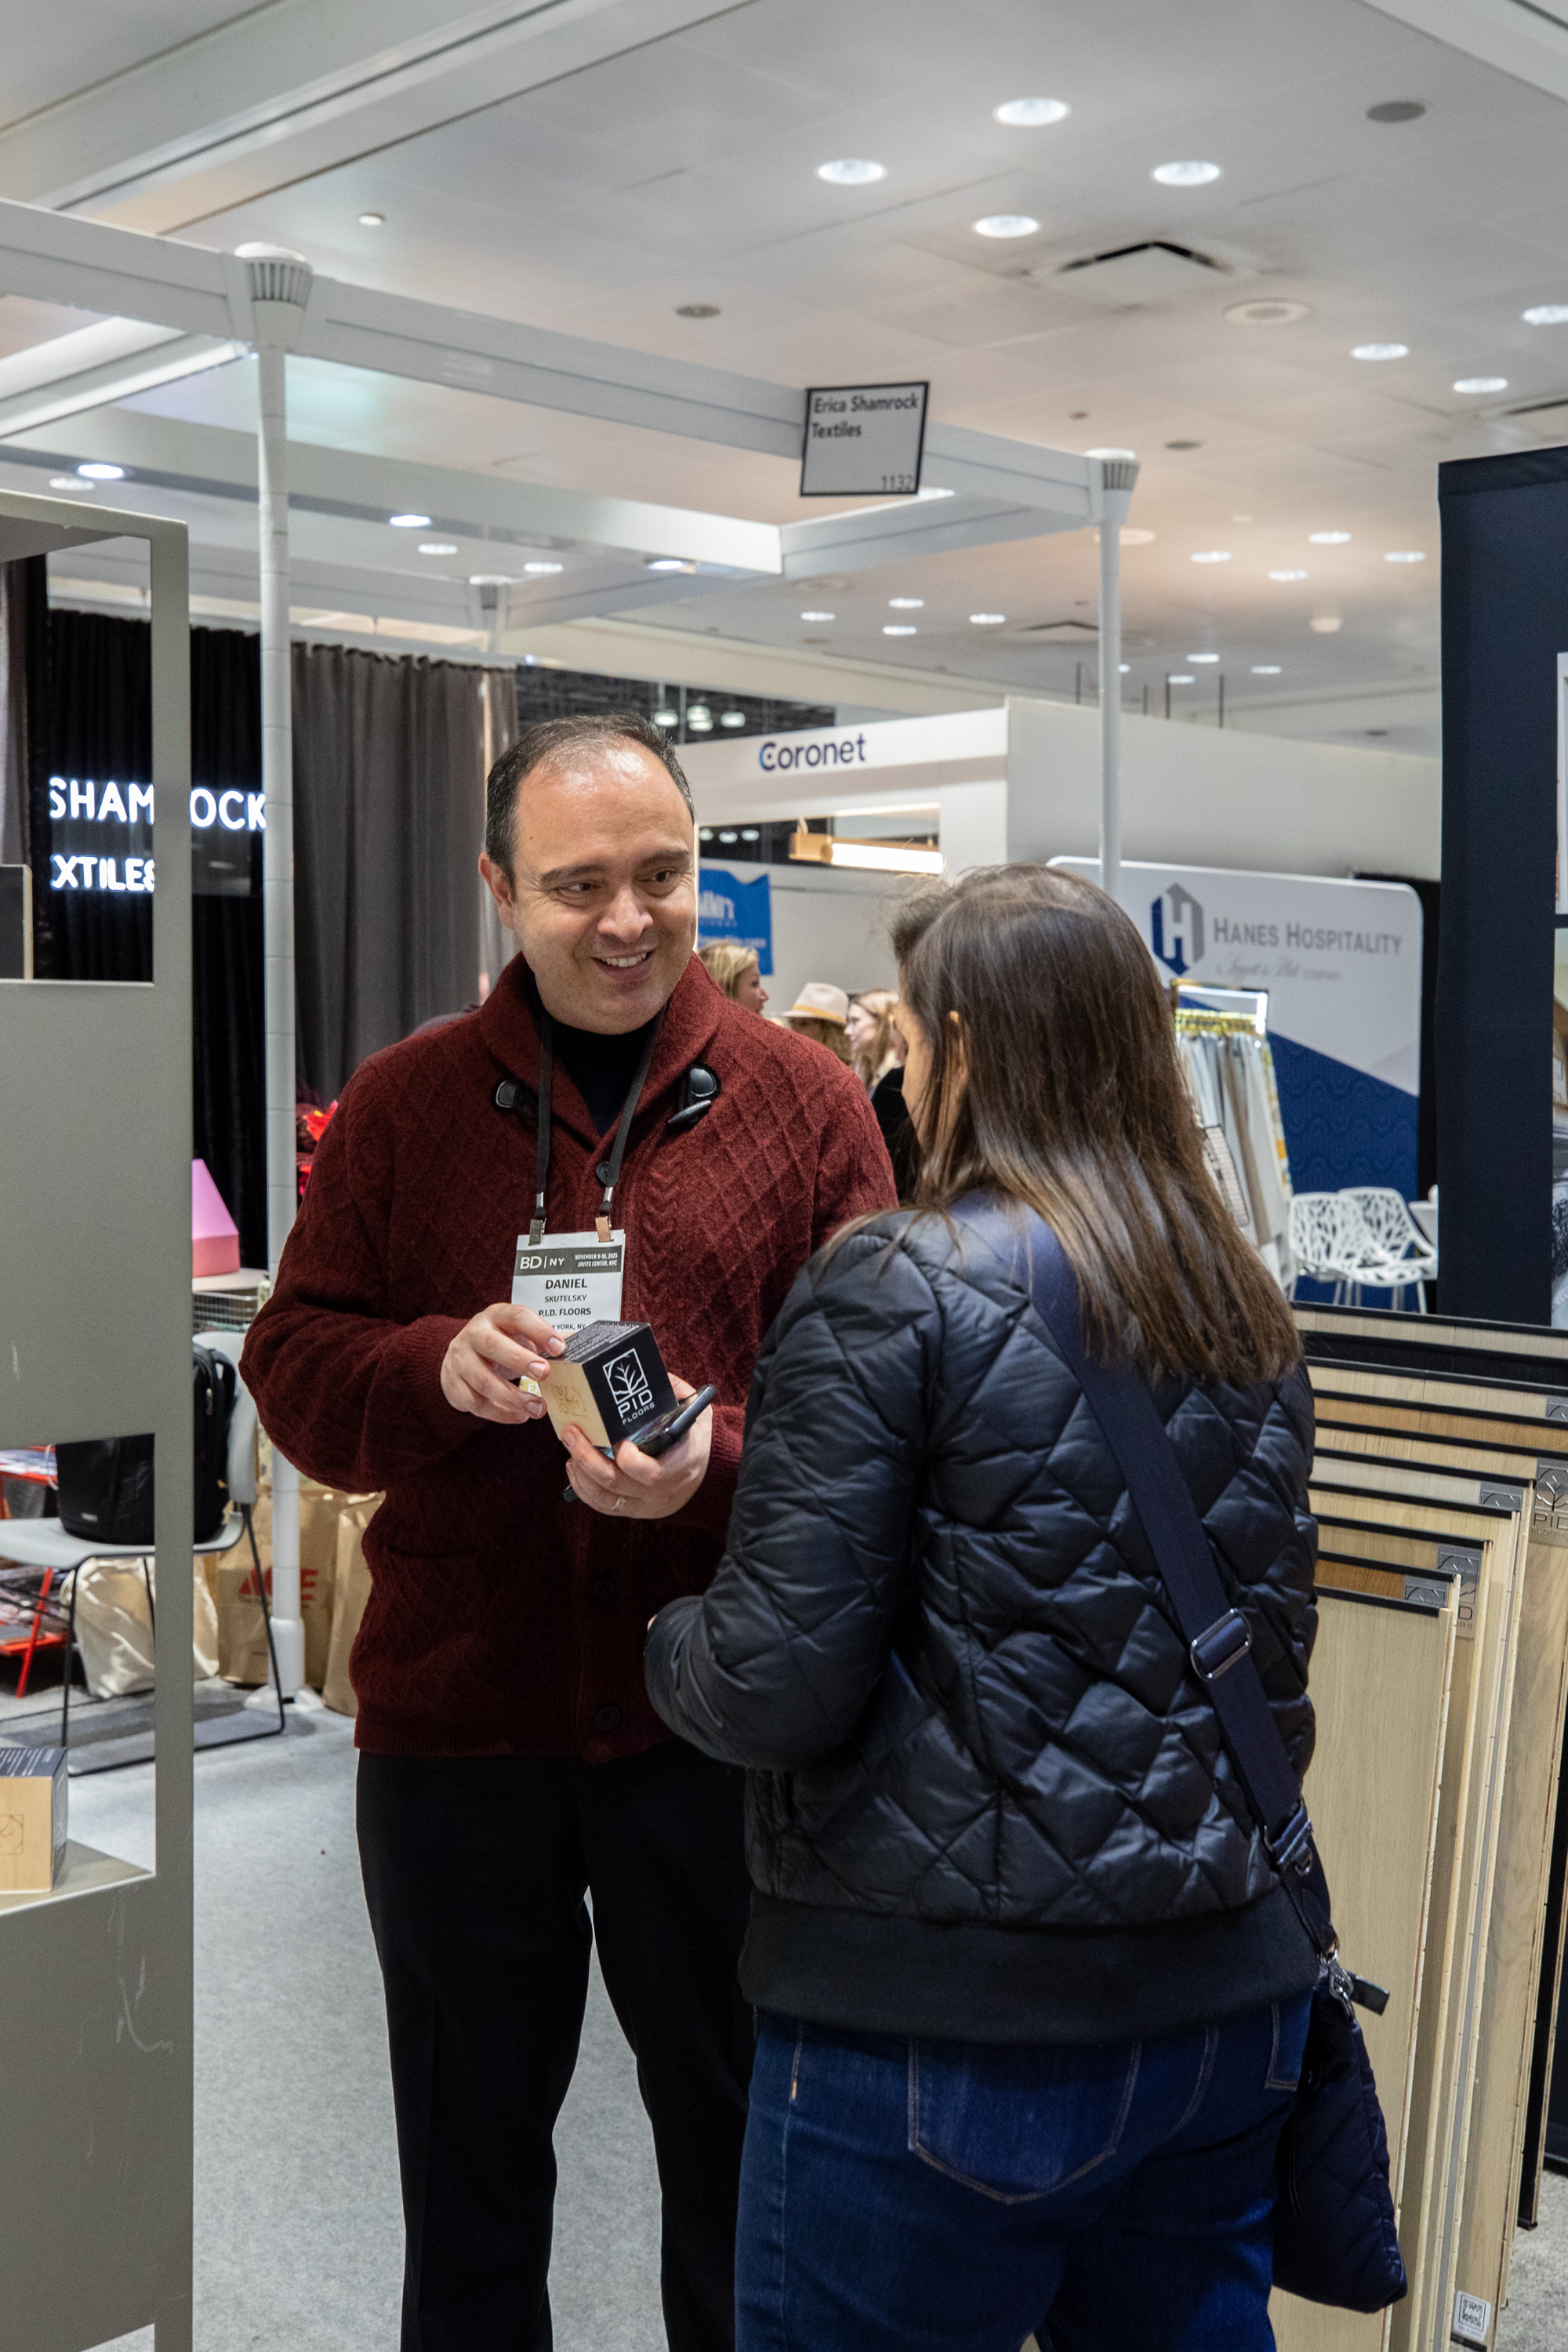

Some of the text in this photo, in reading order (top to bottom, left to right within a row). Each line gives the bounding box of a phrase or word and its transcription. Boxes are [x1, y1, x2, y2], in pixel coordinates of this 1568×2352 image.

[813, 393, 919, 414] Erica Shamrock
[812, 420, 862, 438] Textiles
[881, 474, 914, 492] 1132
[758, 733, 866, 771] Coronet
[49, 776, 267, 831] SHAMOCK
[1213, 916, 1403, 956] HANES HOSPITALITY
[546, 1279, 588, 1289] DANIEL
[544, 1294, 587, 1303] SKUTELSKY
[618, 1389, 652, 1418] PID
[622, 1402, 655, 1425] FLOORS
